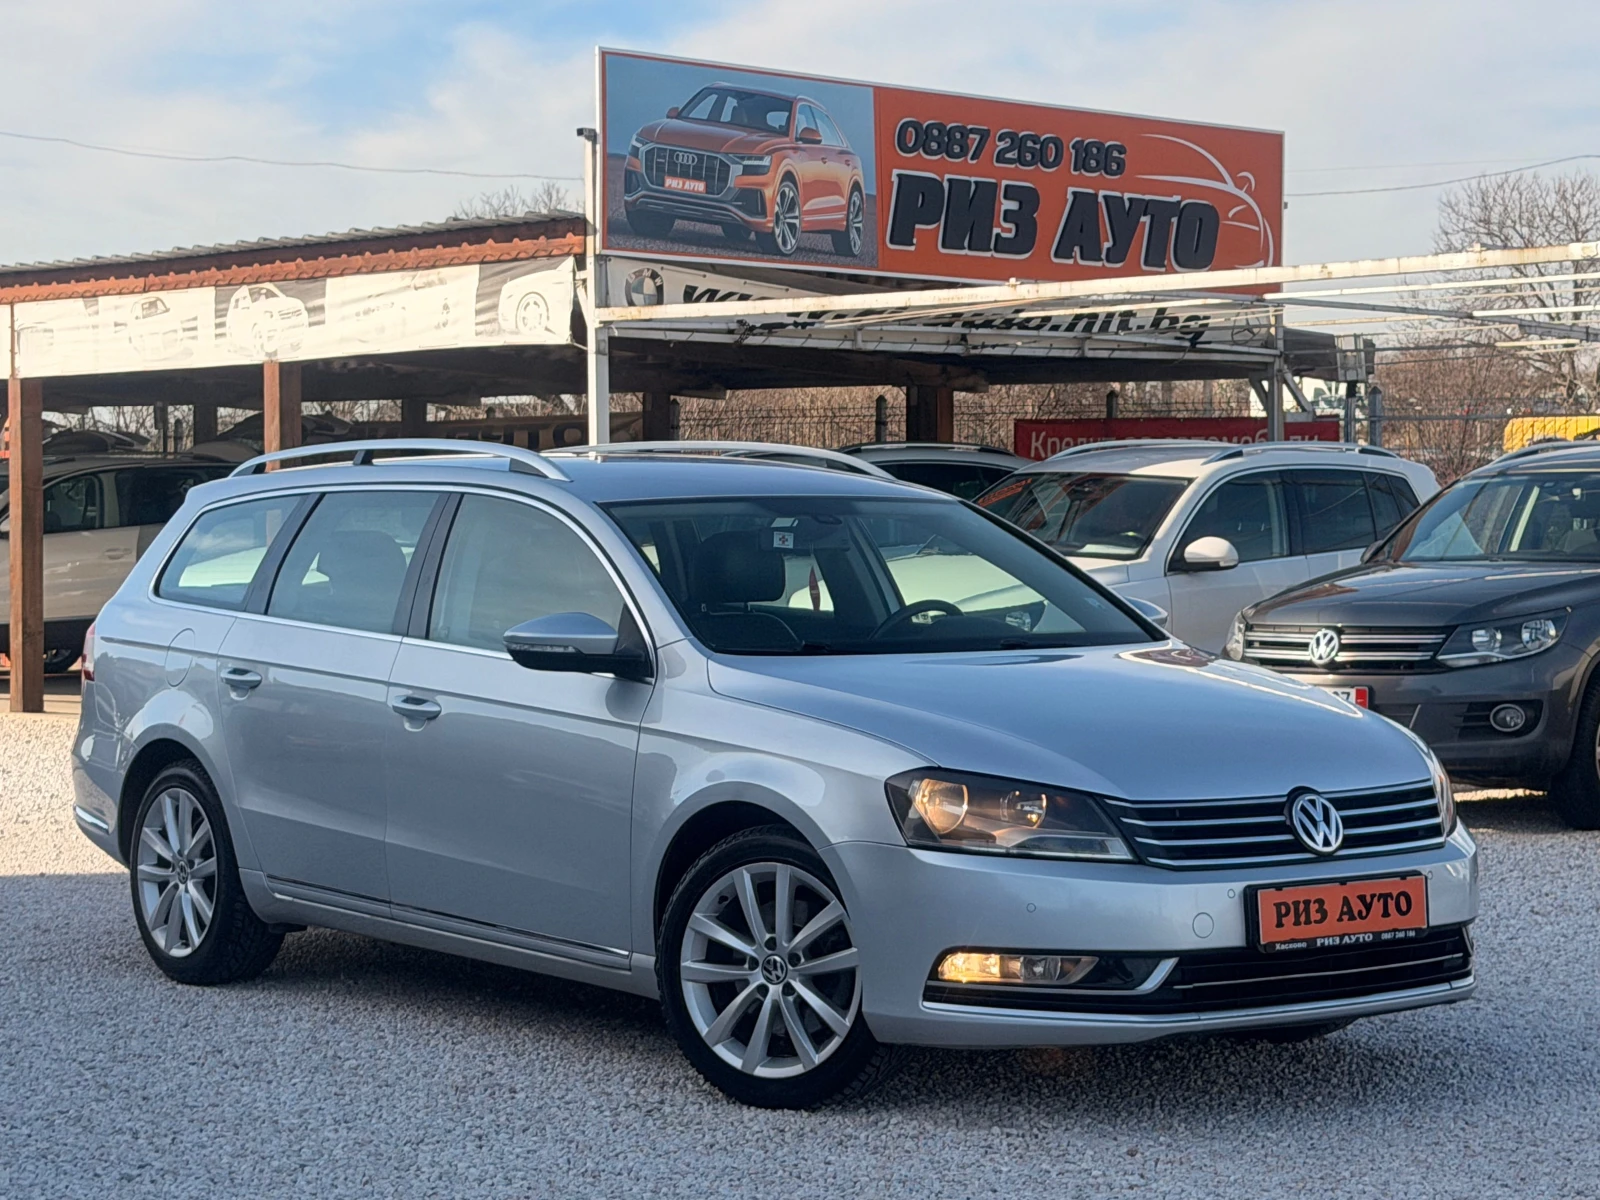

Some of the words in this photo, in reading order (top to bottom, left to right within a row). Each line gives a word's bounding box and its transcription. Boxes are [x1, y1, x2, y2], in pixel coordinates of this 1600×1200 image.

[896, 118, 990, 163] 0887
[994, 129, 1064, 171] 260
[1070, 137, 1127, 177] 186
[886, 169, 1040, 259] РИЗ
[1051, 187, 1220, 272] АУТО
[1273, 898, 1328, 928] РИЗ
[1337, 891, 1412, 922] АУТО
[1316, 936, 1340, 947] РИЗ
[1341, 933, 1373, 944] АУТО
